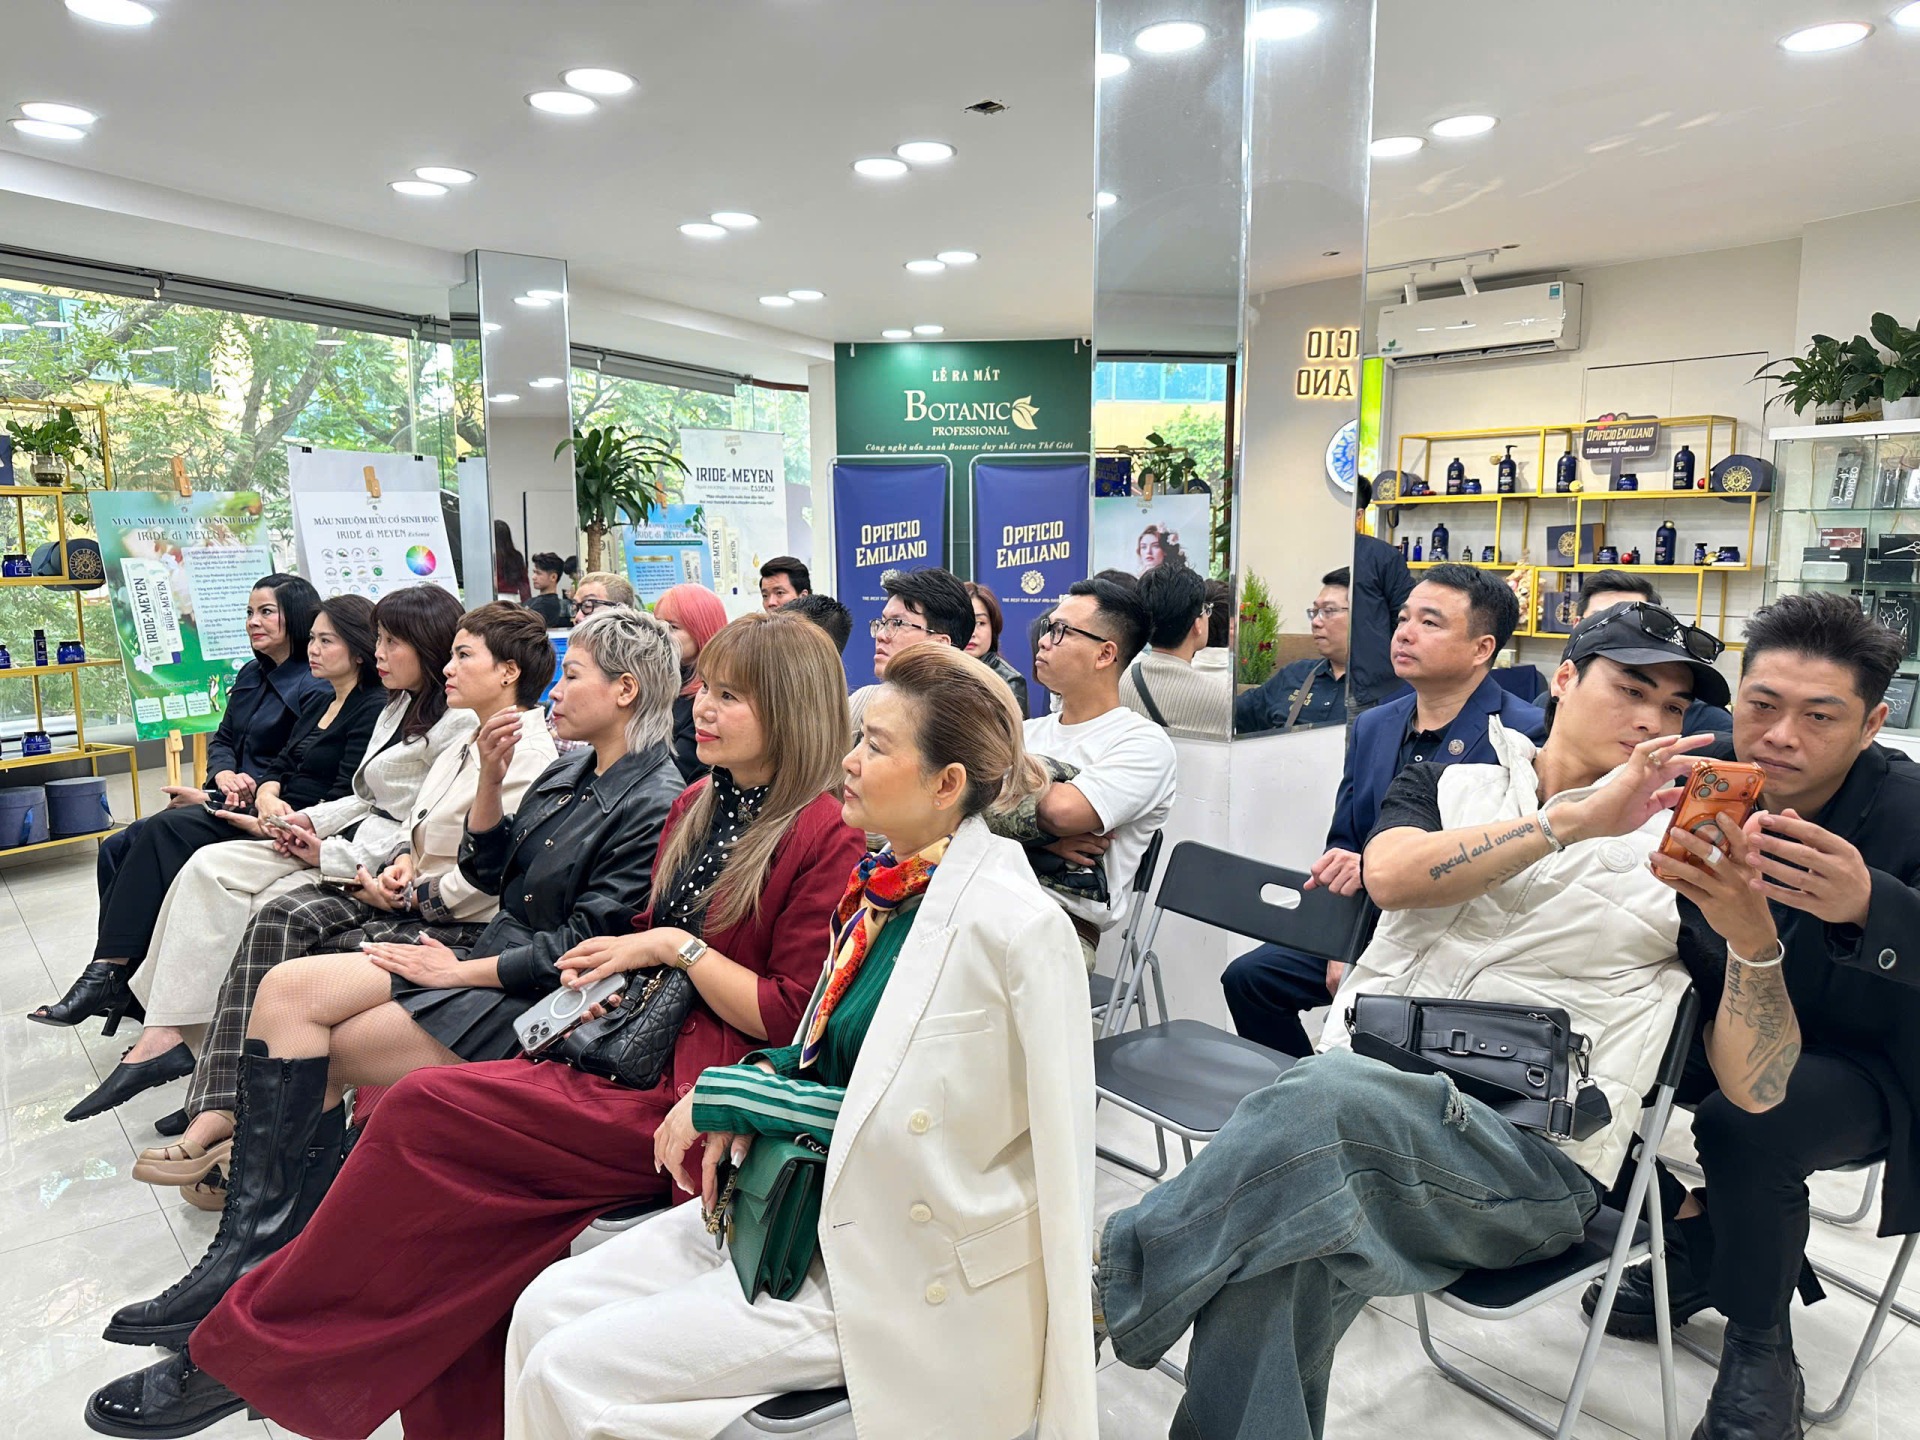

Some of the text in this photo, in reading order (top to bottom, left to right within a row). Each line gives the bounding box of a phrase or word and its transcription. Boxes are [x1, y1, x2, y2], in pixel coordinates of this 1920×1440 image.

[932, 366, 1000, 382] LỄ RA MẮT
[932, 426, 1010, 436] PROFESSIONAL
[1587, 427, 1654, 441] OPIFICIO EMILIANO
[866, 444, 885, 452] Công
[982, 443, 996, 452] duy
[999, 442, 1017, 450] nhất
[1020, 442, 1036, 450] trên
[696, 468, 726, 482] IRIDE
[732, 468, 773, 483] MEYEN
[1844, 467, 1859, 502] TONDEO
[314, 516, 334, 525] MÀU
[335, 516, 367, 525] NHUỘM
[862, 519, 920, 545] OPIFICIO
[1003, 520, 1063, 546] OPIFICIO
[138, 532, 168, 541] IRIDE
[172, 531, 181, 540] di
[186, 531, 219, 539] MEYEN
[337, 530, 362, 539] IRIDE
[366, 529, 374, 538] di
[377, 529, 406, 538] MEYEN
[712, 530, 720, 557] MEYEN
[856, 540, 927, 568] EMILIANO
[996, 541, 1070, 568] EMILIANO
[133, 578, 152, 613] MEYEN
[156, 581, 175, 631] IRIDE MEYEN
[143, 617, 158, 643] IRIDE
[1430, 823, 1535, 880] special and unique
